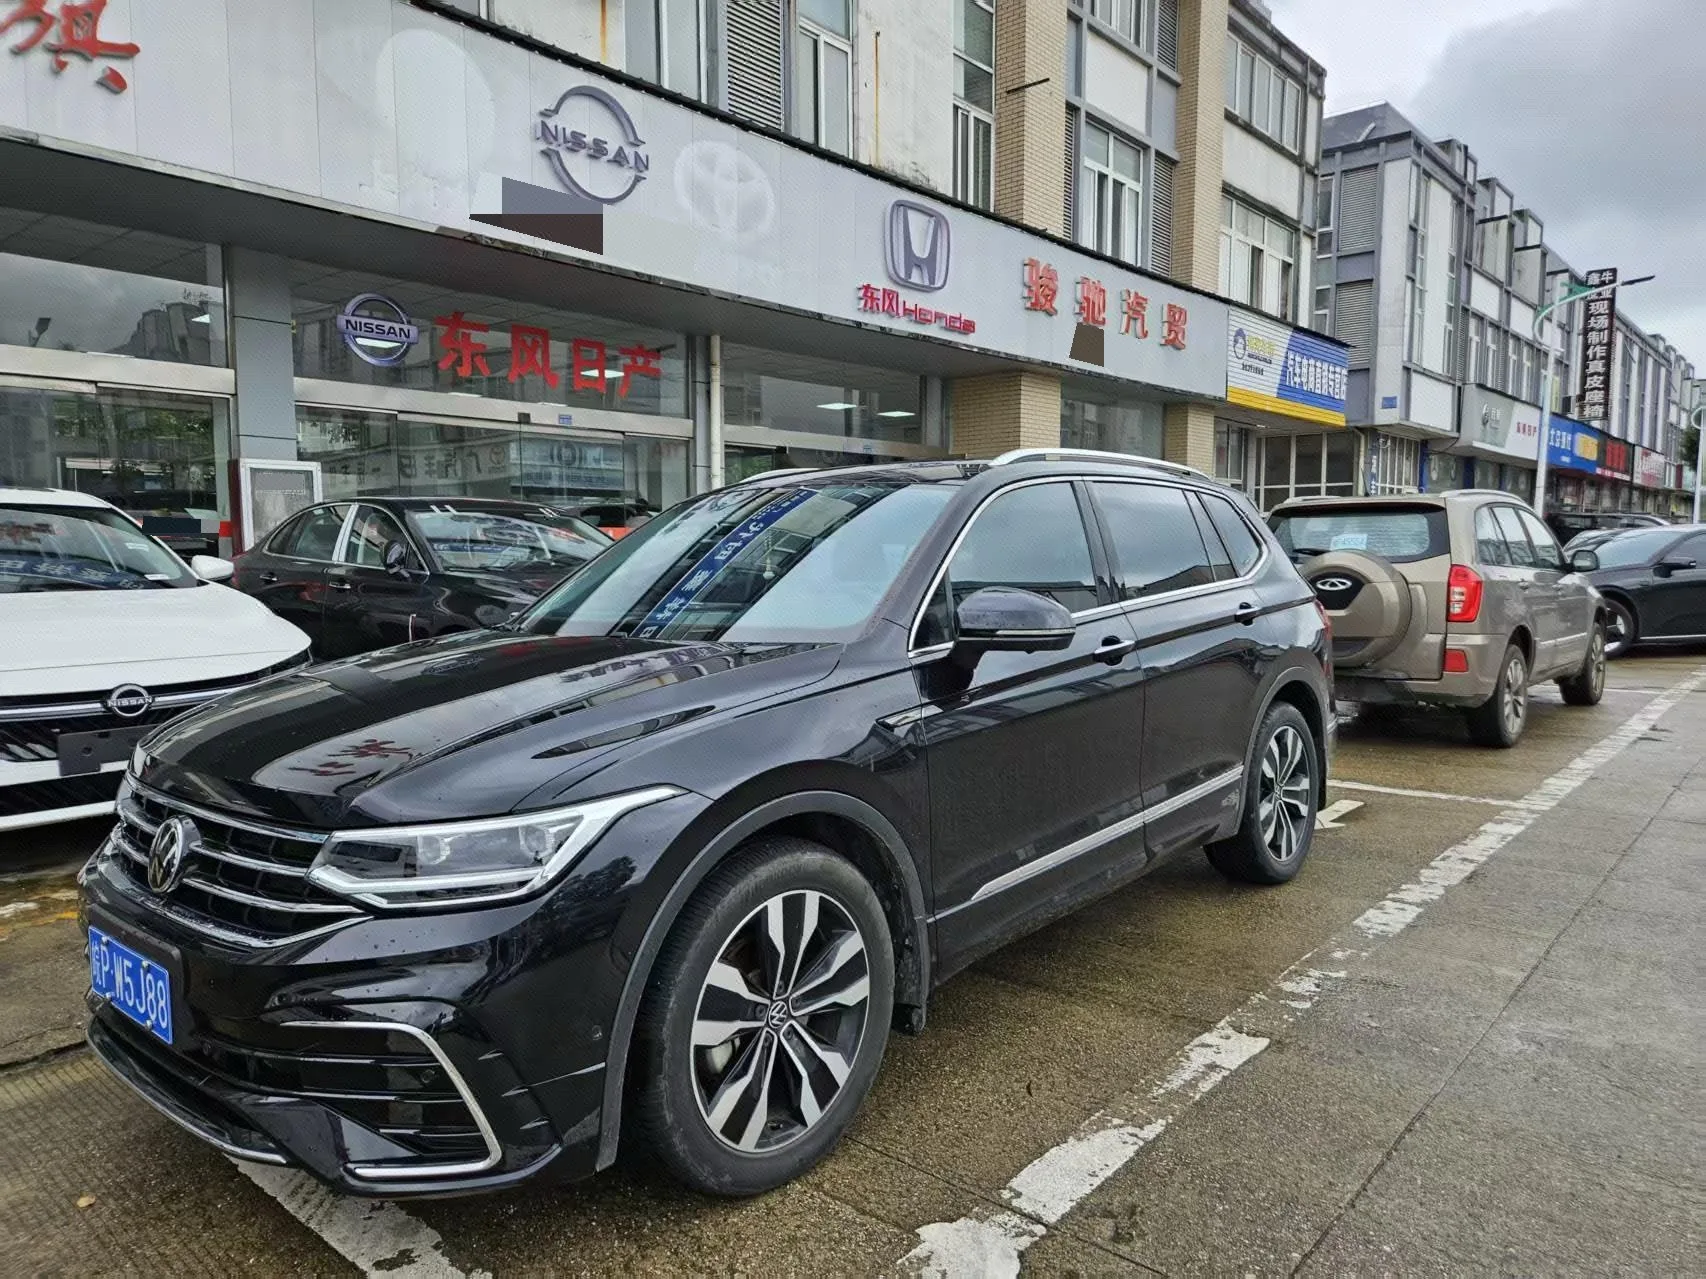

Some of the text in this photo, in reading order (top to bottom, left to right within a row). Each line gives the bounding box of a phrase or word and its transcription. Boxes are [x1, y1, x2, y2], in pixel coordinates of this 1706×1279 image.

[534, 119, 650, 173] NISSAN
[344, 318, 411, 340] NISSAN
[1022, 257, 1189, 350] 骏驰汽贸
[434, 311, 662, 398] 东风日产
[107, 696, 153, 707] NISSAN
